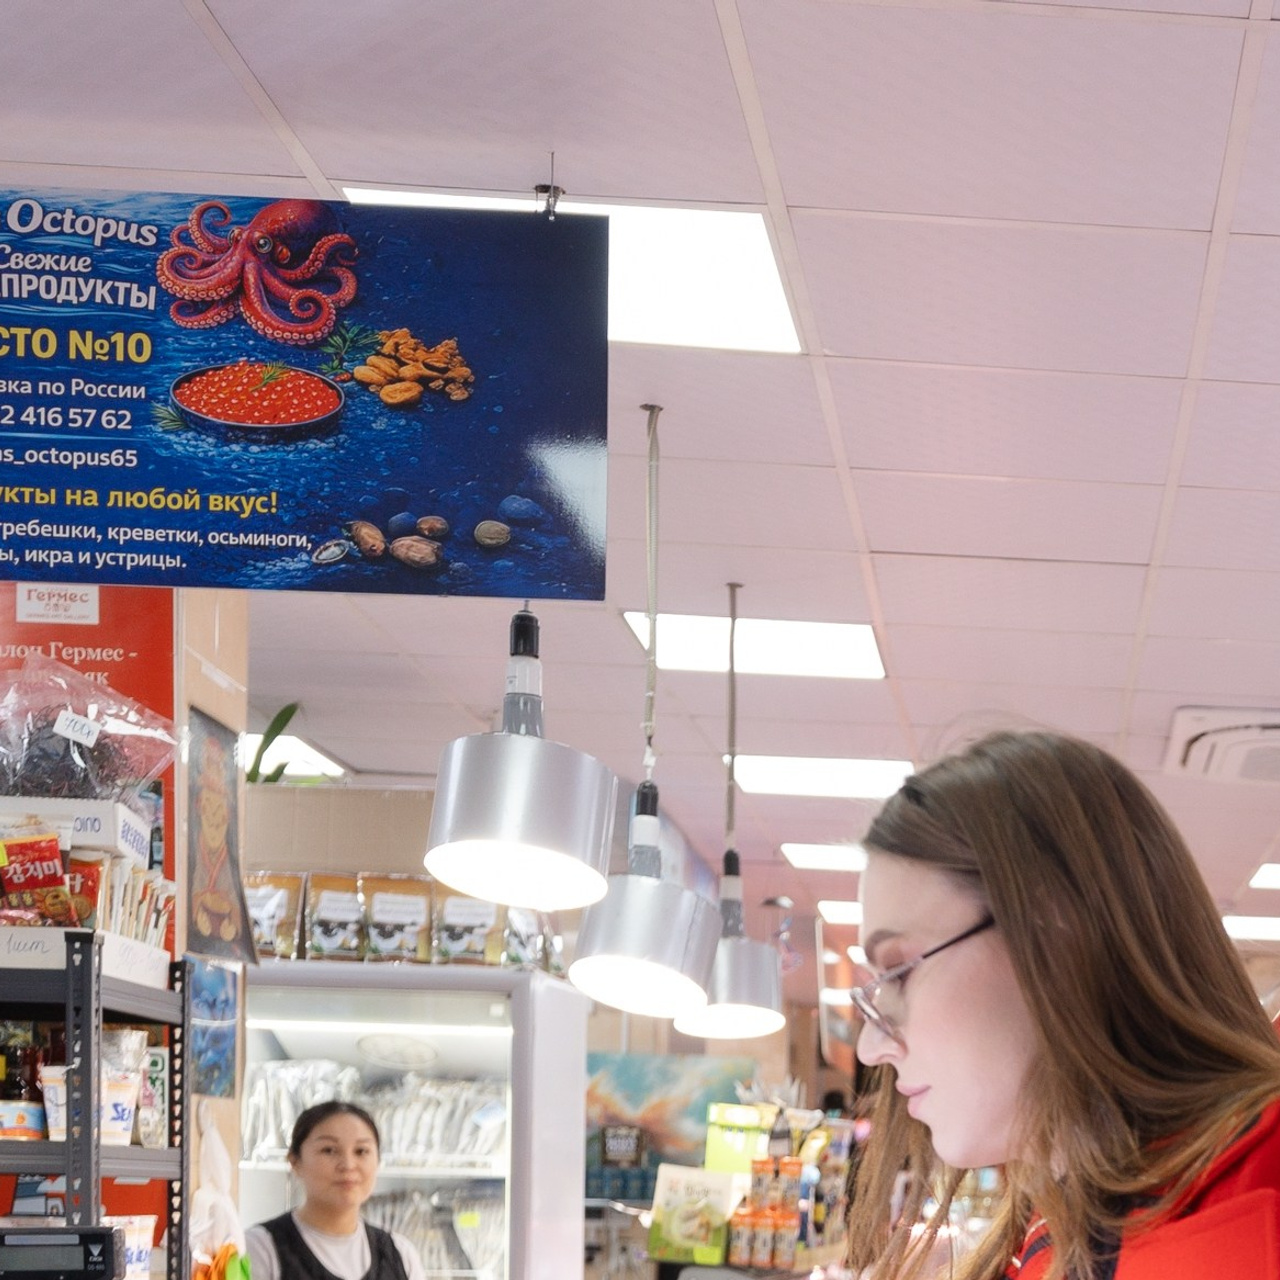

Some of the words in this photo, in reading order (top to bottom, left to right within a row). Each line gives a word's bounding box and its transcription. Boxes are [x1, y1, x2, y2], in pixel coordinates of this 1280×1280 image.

[7, 199, 158, 246] Octopus
[0, 244, 92, 272] Свежие
[69, 330, 152, 363] №10
[38, 381, 65, 395] по
[71, 378, 146, 399] России
[20, 406, 63, 426] 416
[68, 408, 97, 428] 57
[101, 409, 132, 430] 62
[65, 490, 99, 507] на
[107, 488, 200, 511] любой
[208, 492, 278, 519] вкус!
[0, 519, 102, 543] ребешки,
[107, 526, 204, 547] креветки,
[208, 532, 312, 551] осьминоги,
[25, 549, 73, 568] икра
[78, 551, 91, 564] и
[95, 551, 187, 571] устрицы.
[26, 588, 89, 604] Гермес
[48, 641, 123, 664] Гермес
